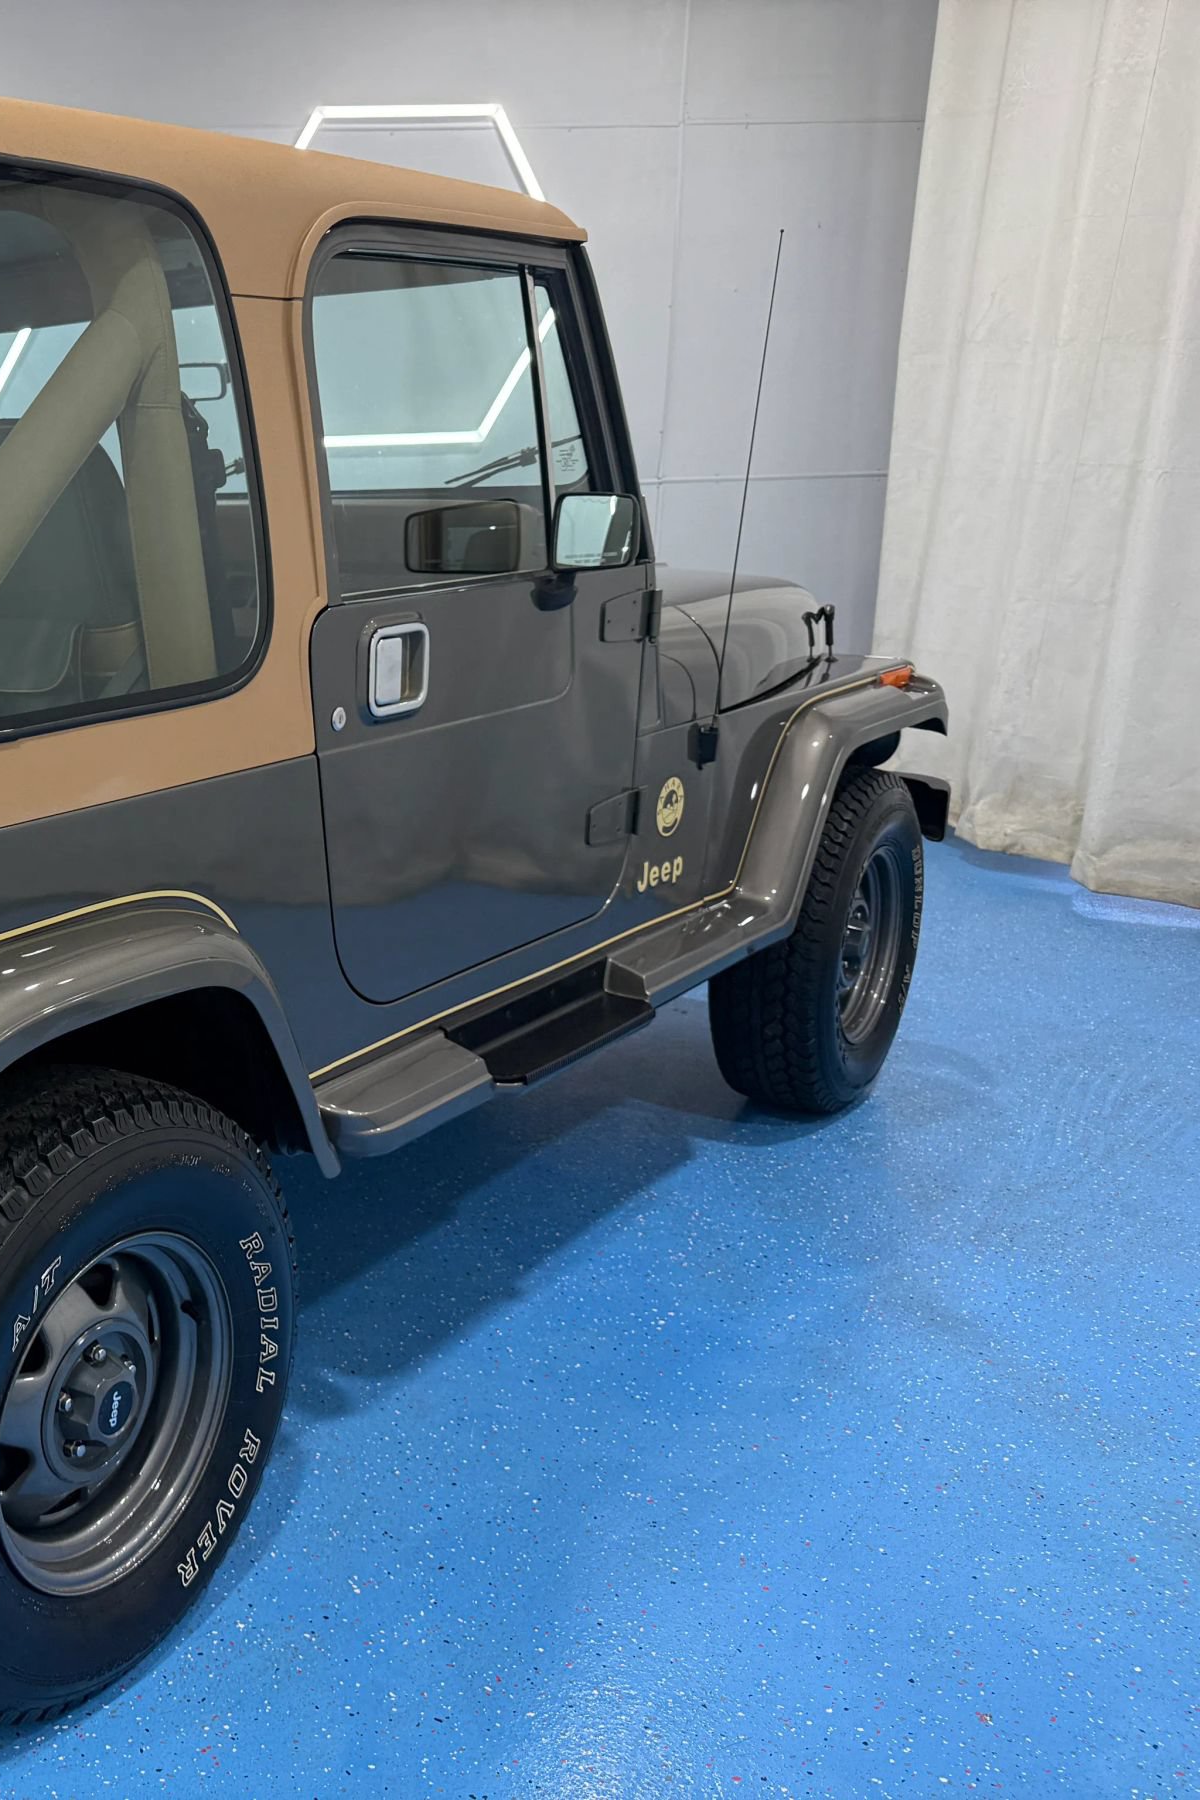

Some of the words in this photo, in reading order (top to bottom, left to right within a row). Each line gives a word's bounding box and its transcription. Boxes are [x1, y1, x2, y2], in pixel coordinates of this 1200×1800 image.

[637, 856, 683, 892] Jeep
[12, 1256, 63, 1352] A/T
[239, 1231, 280, 1393] RADIAL
[108, 1390, 122, 1428] Jeep
[177, 1428, 262, 1588] ROVER
